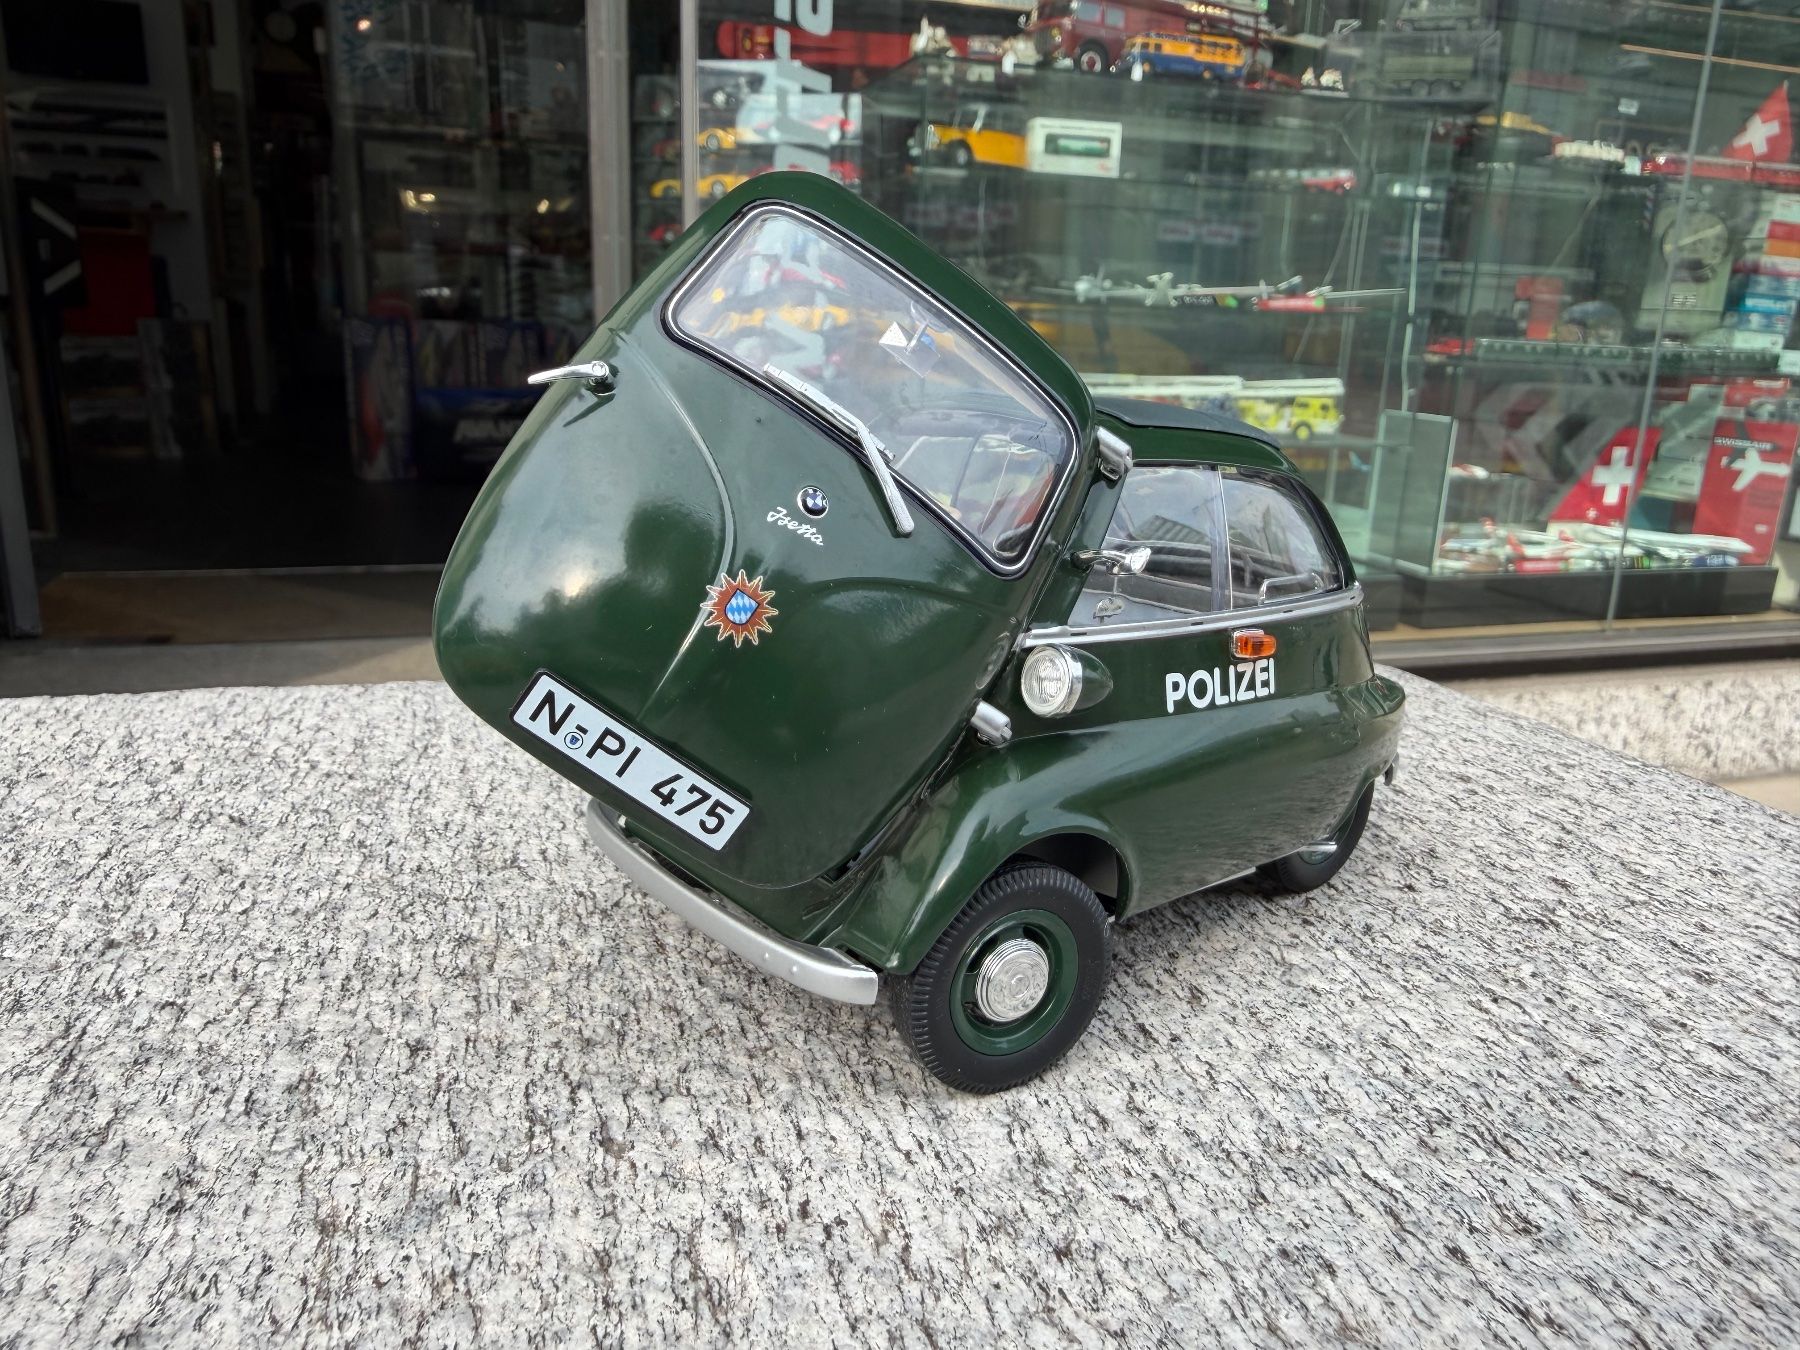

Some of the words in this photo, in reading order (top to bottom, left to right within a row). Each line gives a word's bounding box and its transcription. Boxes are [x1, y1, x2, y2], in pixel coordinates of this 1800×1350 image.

[767, 507, 823, 546] Isetta
[1166, 657, 1275, 713] POLIZEI
[650, 773, 734, 834] 475
